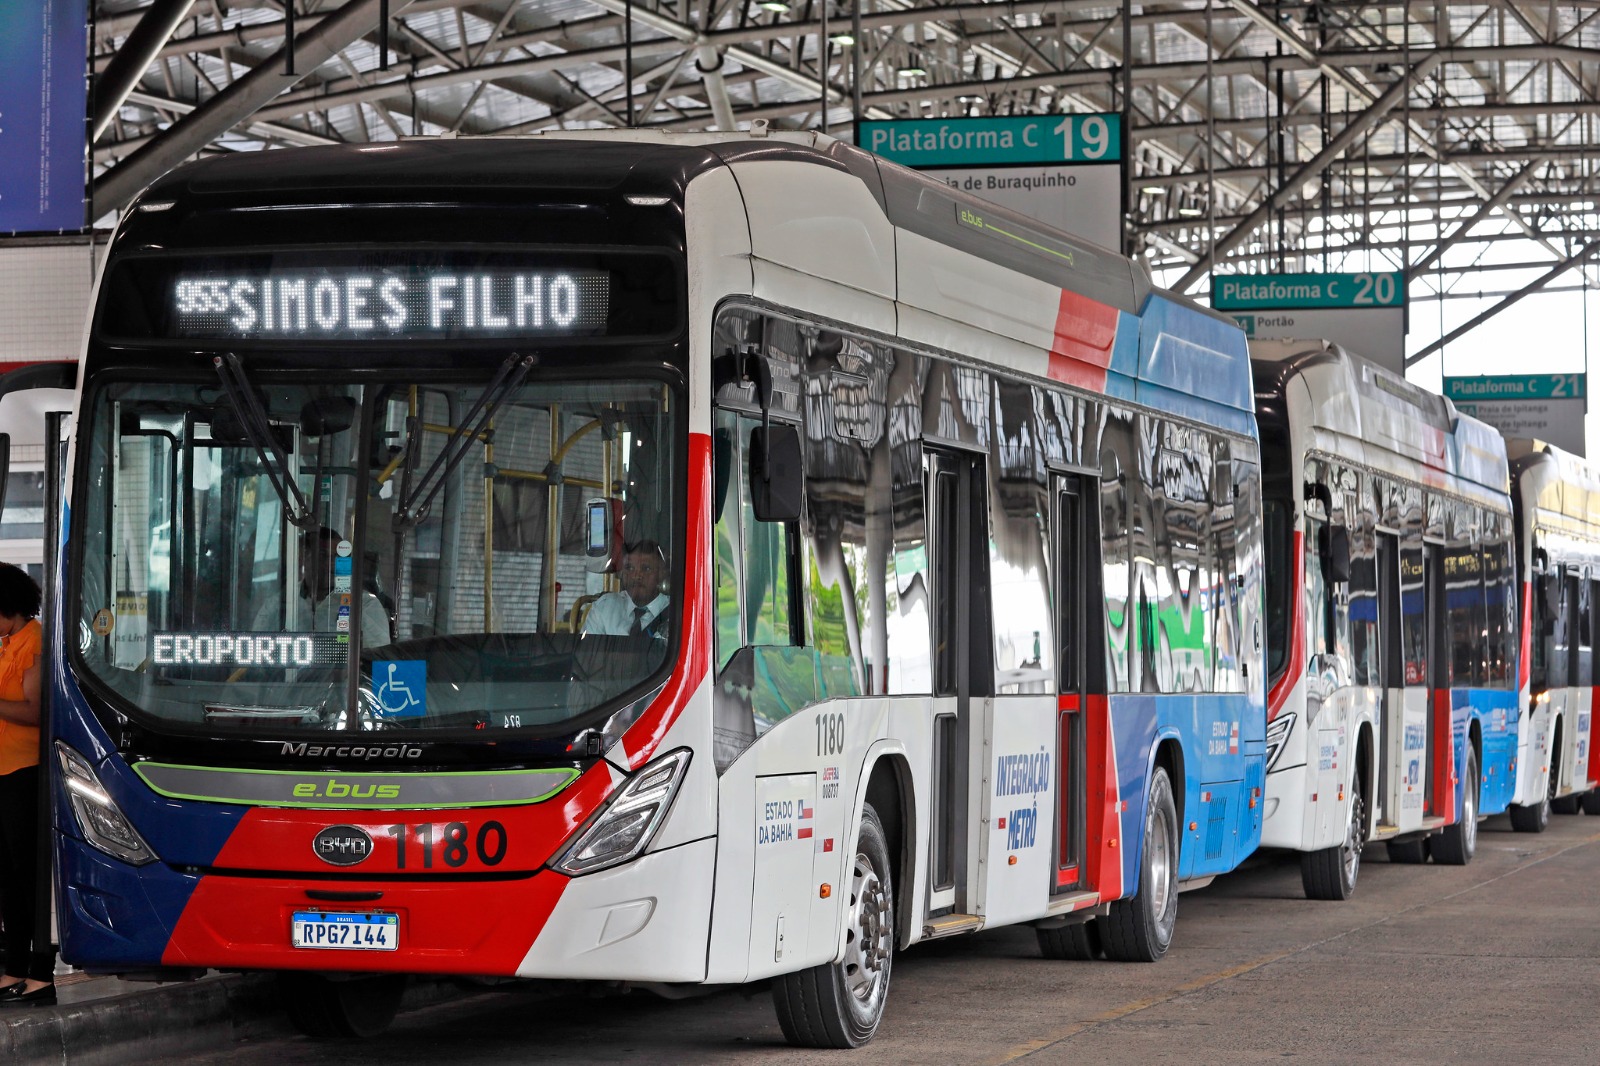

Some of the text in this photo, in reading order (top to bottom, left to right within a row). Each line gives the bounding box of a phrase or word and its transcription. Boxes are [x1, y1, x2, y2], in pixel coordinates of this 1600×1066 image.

[872, 116, 1110, 160] Plataforma C 19
[964, 176, 982, 190] de
[987, 173, 1077, 191] Buraquinho
[961, 209, 983, 228] e.bus
[1223, 273, 1396, 305] Plataforma C 20
[230, 277, 407, 330] SIMOES
[430, 275, 577, 328] FILHO
[1257, 315, 1295, 327] Portão
[1452, 374, 1579, 397] Plataforma C 21
[153, 634, 314, 665] EROPORTO
[815, 712, 845, 757] 1180
[280, 742, 423, 760] Marcopolo
[996, 745, 1050, 799] INTEGRAÇÃO
[292, 779, 401, 799] e.bus
[765, 800, 793, 821] ESTADO
[759, 822, 793, 845] DA BAHIA
[1006, 800, 1037, 851] METRÔ
[319, 836, 367, 855] BYD
[387, 820, 508, 869] 1180
[303, 923, 387, 946] RPG7I44
